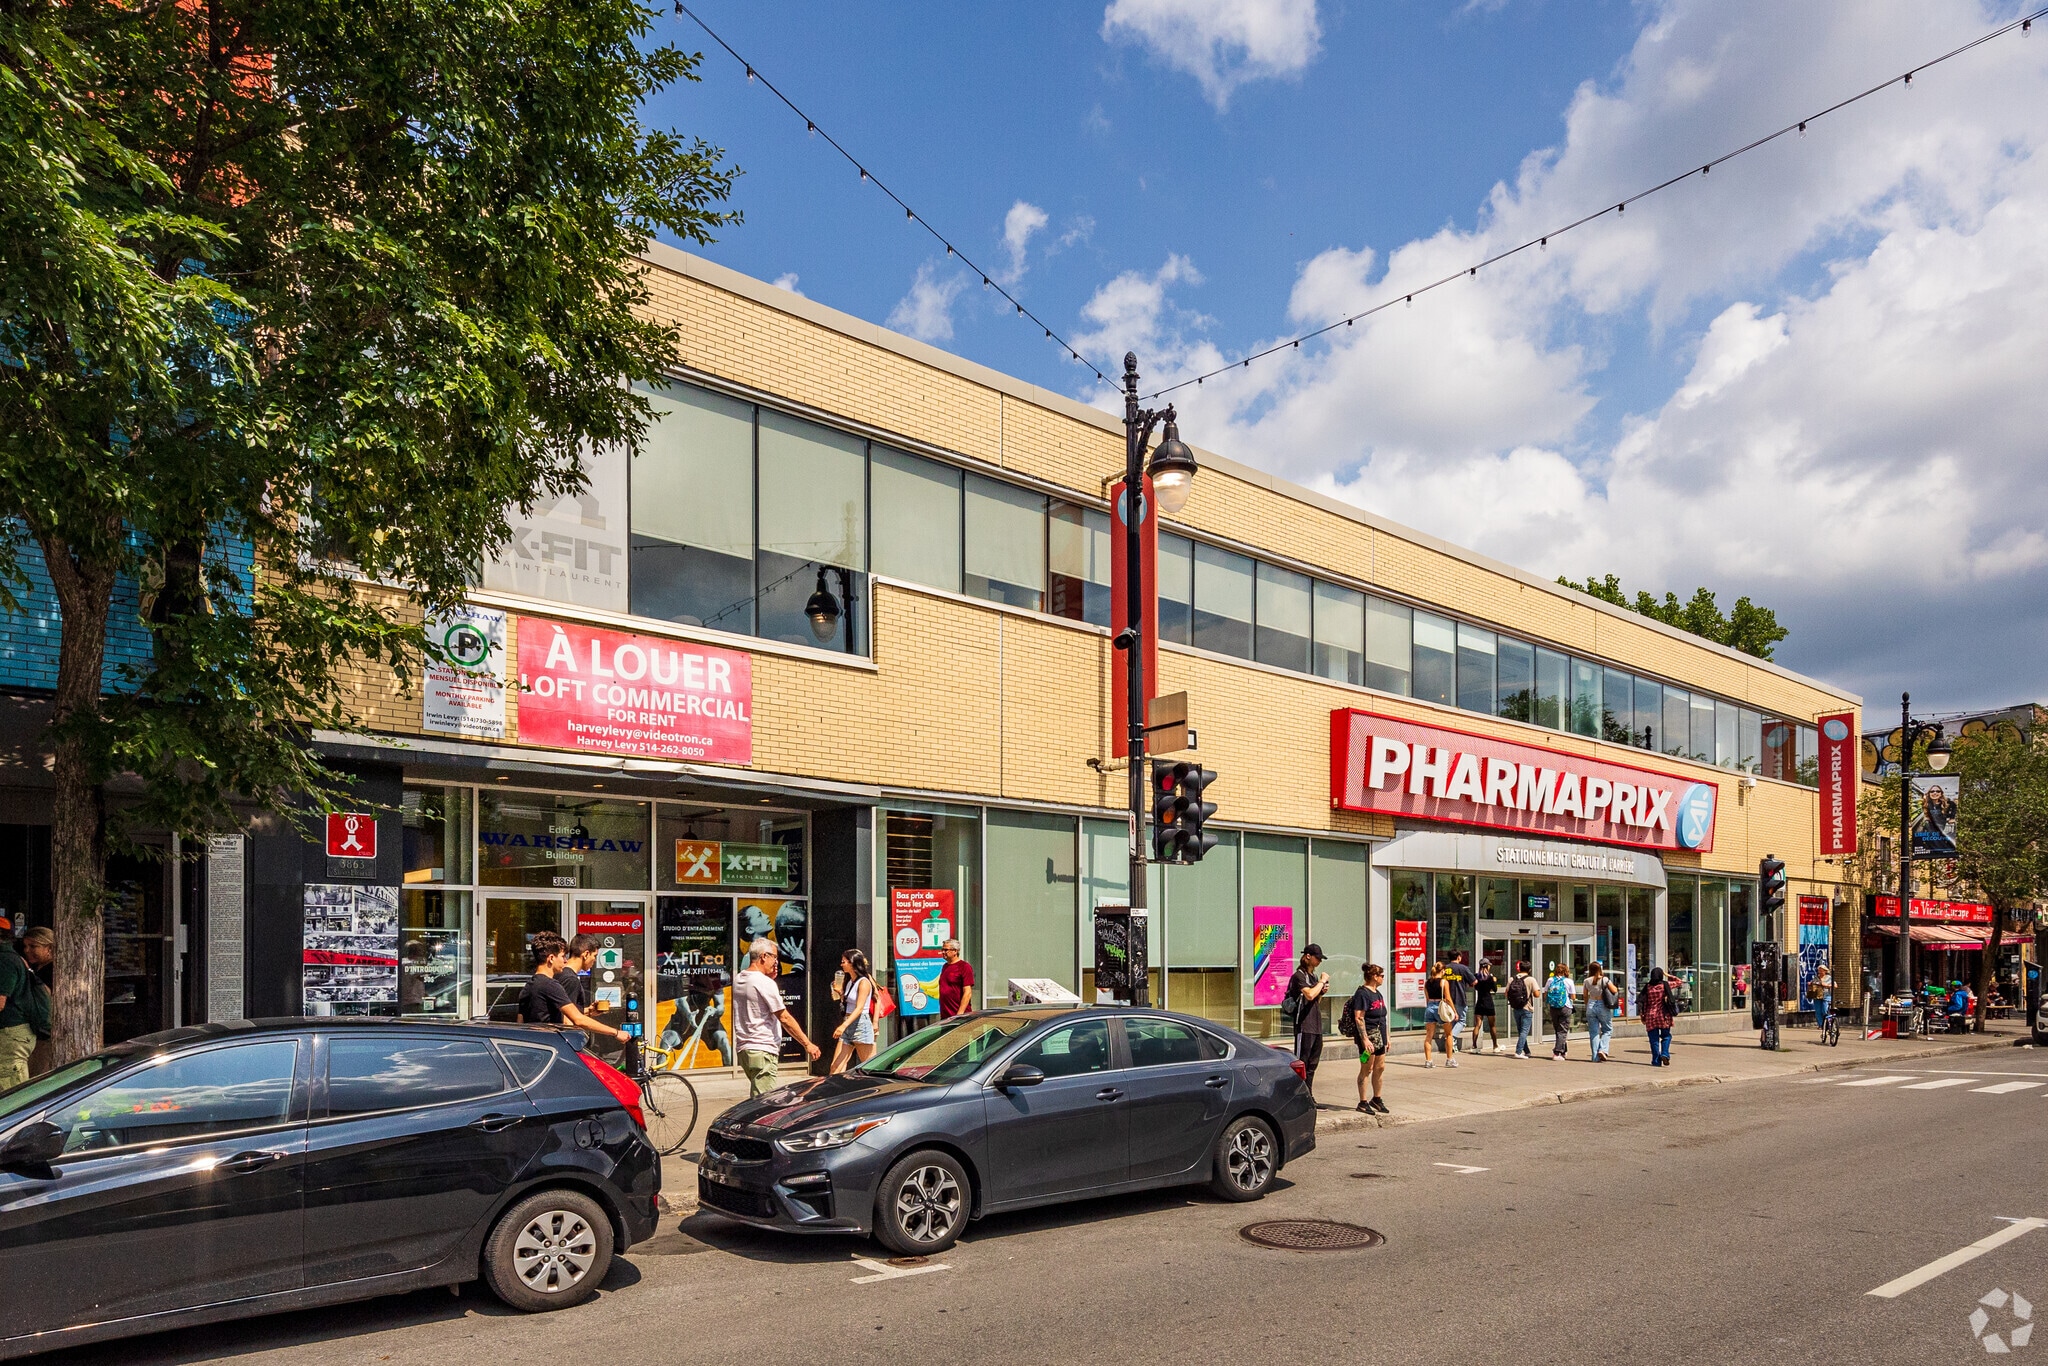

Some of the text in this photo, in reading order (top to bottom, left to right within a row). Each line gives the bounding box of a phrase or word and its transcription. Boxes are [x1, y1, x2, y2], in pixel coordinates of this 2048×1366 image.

[545, 625, 732, 693] À LOUER
[429, 674, 461, 684] MENSUEL
[435, 691, 495, 704] MONTHLY PARKING
[521, 673, 749, 722] LOFT COMMERCIAL
[449, 701, 482, 710] AVAILABLE
[426, 711, 442, 719] Irwin
[607, 708, 677, 727] FOR RENT
[567, 719, 713, 746] harveylevy@videotron.ca
[577, 735, 705, 757] Harvey Levy 514-262-8050
[1366, 735, 1673, 830] PHARMAPRIX
[1831, 744, 1843, 849] PHARMAPRIX
[480, 831, 644, 853] WARSHAW
[545, 850, 584, 861] Building
[1497, 847, 1568, 869] STATIONNEMENT
[1571, 853, 1601, 871] GRATUIT
[1602, 854, 1608, 871] À
[553, 877, 577, 886] 3863
[896, 891, 935, 901] Bas prix de
[896, 900, 940, 909] tous les jours
[1260, 924, 1286, 933] UN VENT
[1260, 932, 1268, 940] DE
[1399, 937, 1420, 947] 20 000
